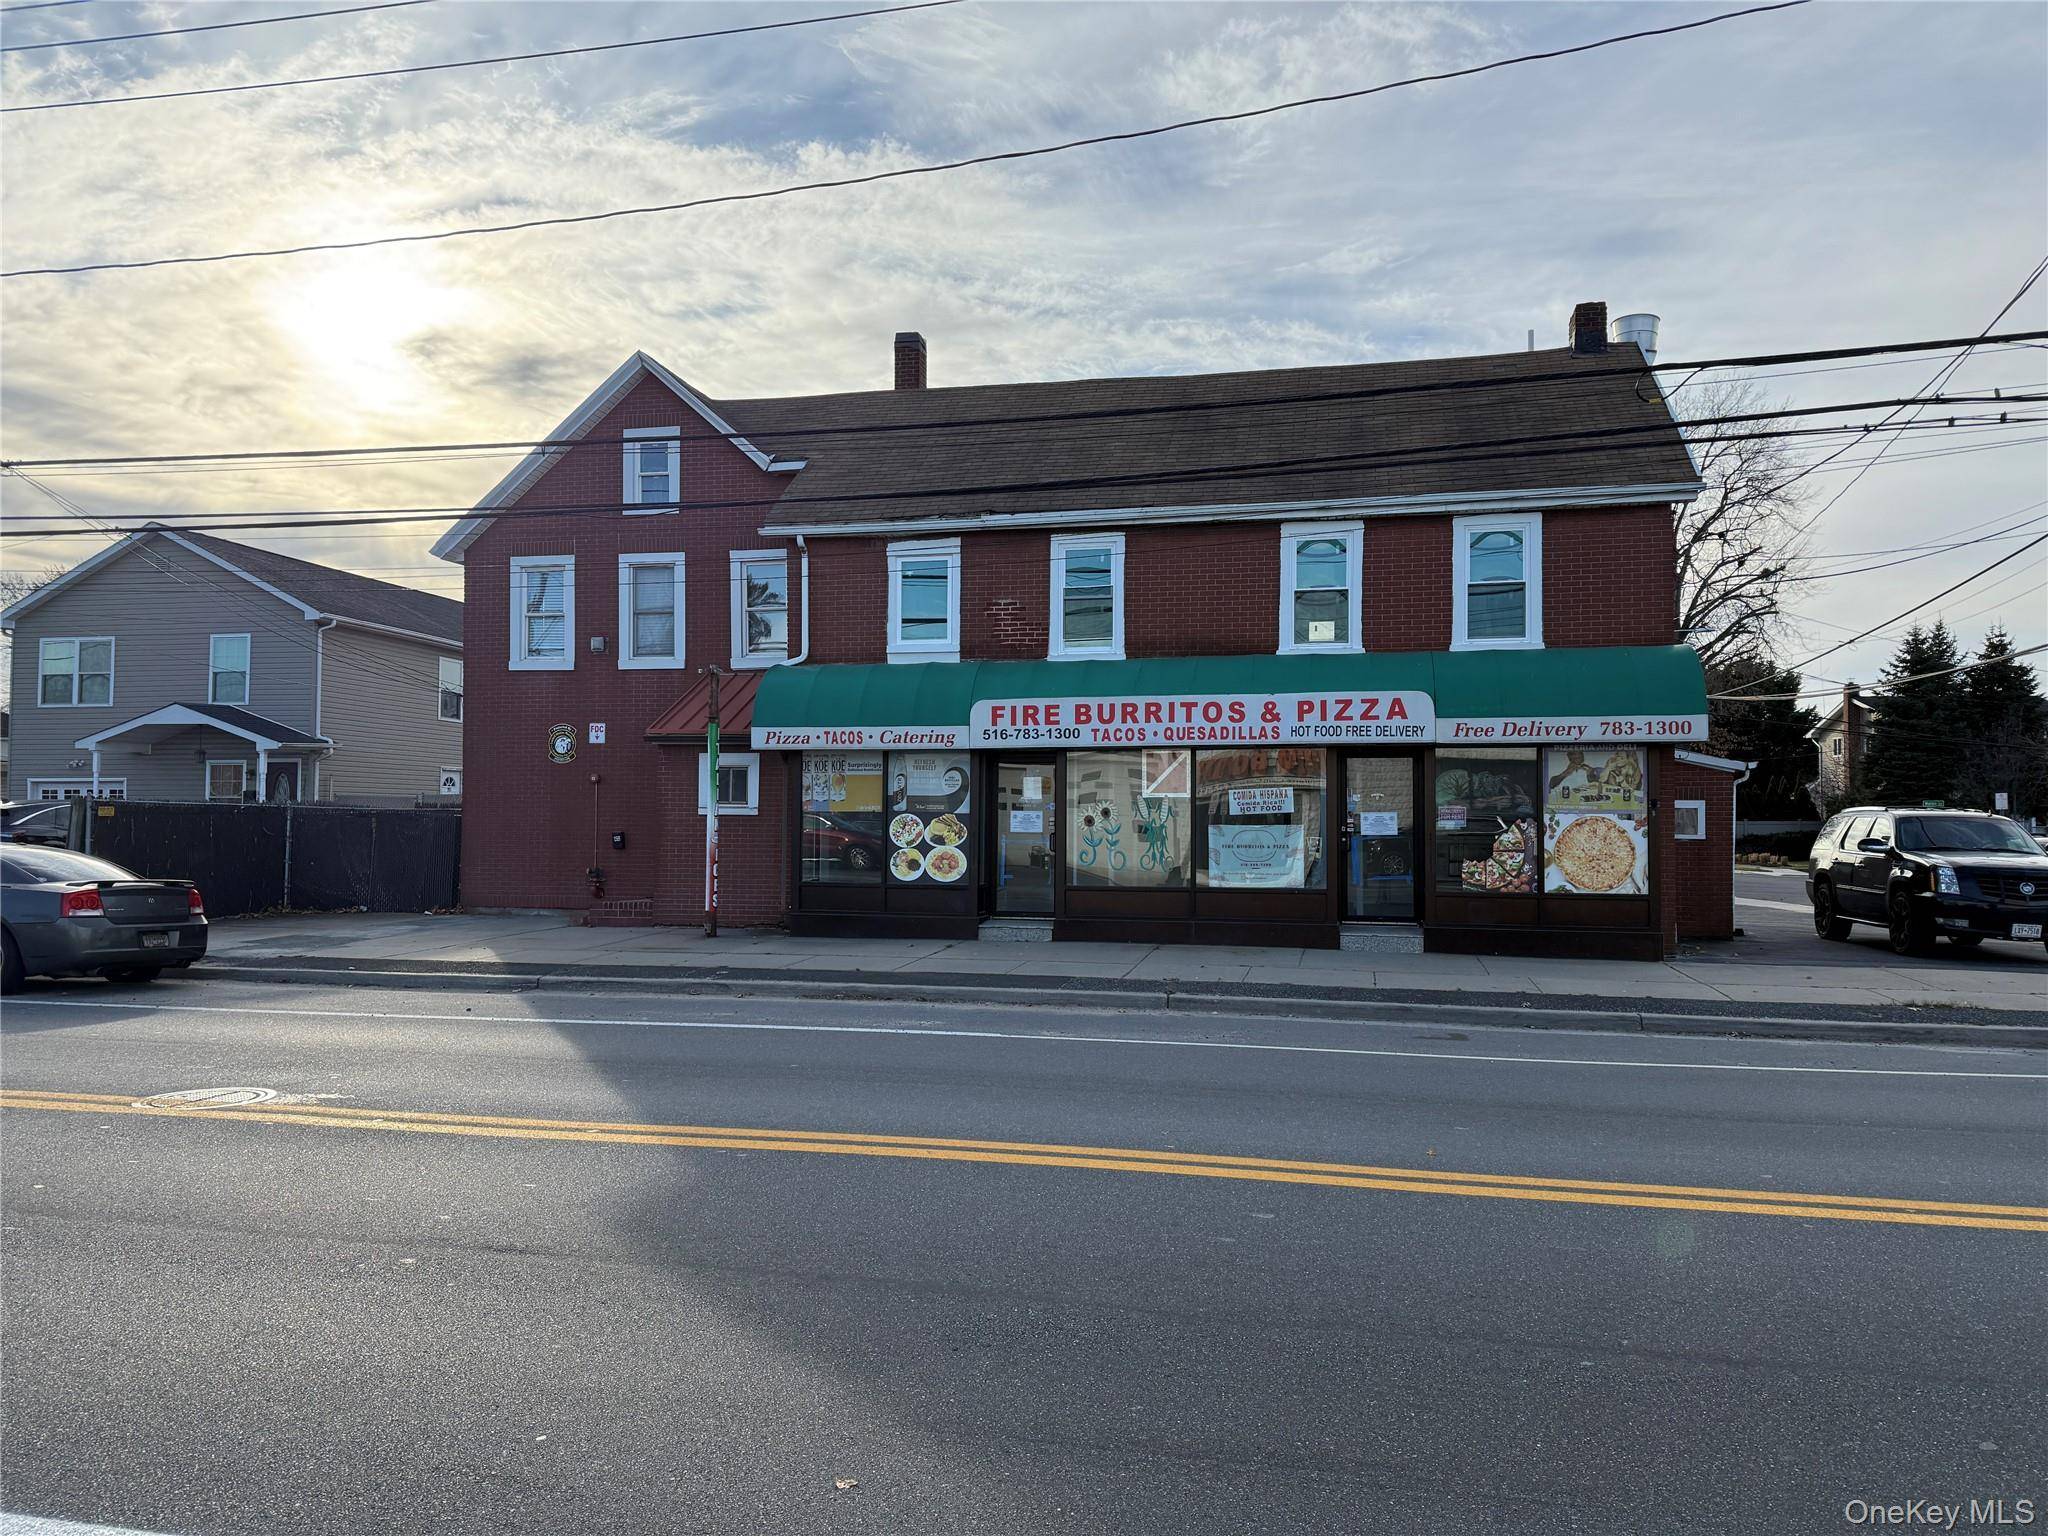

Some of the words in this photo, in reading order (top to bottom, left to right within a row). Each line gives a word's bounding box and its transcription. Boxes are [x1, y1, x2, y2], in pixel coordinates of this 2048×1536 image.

[991, 704, 1061, 727] FIRE
[1074, 701, 1246, 726] BURRITOS
[1261, 701, 1282, 724] &
[1297, 697, 1409, 722] PIZZA
[590, 725, 604, 733] FDC
[982, 728, 1081, 740] 516-783-1300
[1091, 727, 1146, 742] TACOS
[1163, 726, 1281, 742] QUESADILLAS
[1291, 725, 1313, 737] HOT
[1314, 725, 1343, 737] FOOD
[1346, 725, 1372, 737] FREE
[1375, 725, 1426, 737] DELIVERY
[1453, 722, 1495, 737] Free
[1501, 721, 1590, 741] Delivery
[1600, 720, 1693, 735] 783-1300
[765, 731, 811, 745] Pizza
[823, 731, 864, 745] TACOS
[879, 730, 957, 748] Catering
[1232, 790, 1257, 801] COMIDA
[1260, 788, 1289, 800] HISPANA
